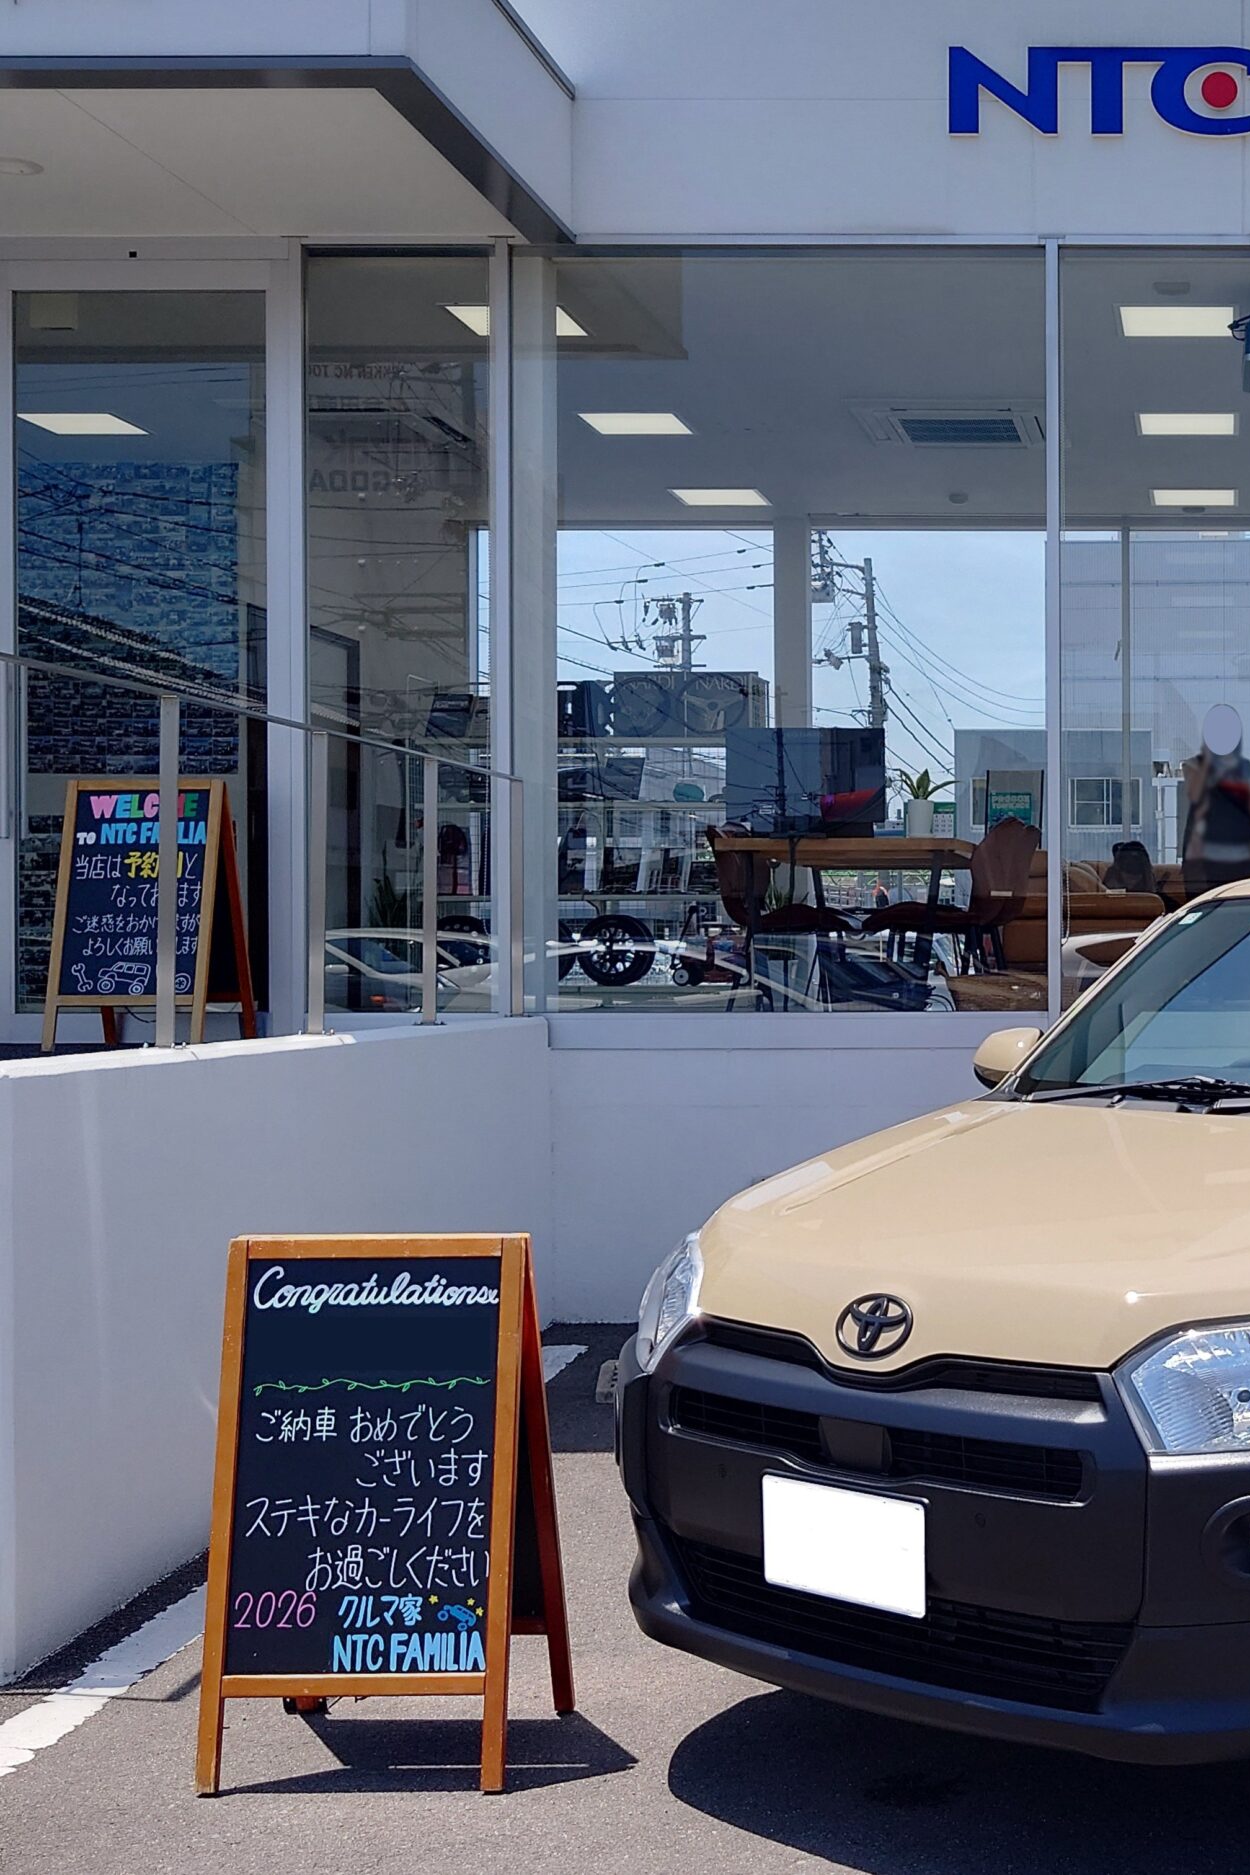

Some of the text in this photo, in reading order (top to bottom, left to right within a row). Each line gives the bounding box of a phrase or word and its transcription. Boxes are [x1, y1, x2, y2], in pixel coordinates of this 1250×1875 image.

[90, 793, 199, 819] WELCE
[76, 821, 207, 845] TO NTC FALIA
[76, 851, 199, 880] 当店は予約と
[110, 881, 202, 908] なっておます
[255, 1404, 474, 1443] ご納車 おめでとう
[355, 1448, 489, 1488] ございます
[245, 1494, 486, 1539] ステキなカーライフを
[305, 1544, 490, 1592] お過ごしください
[233, 1590, 317, 1629] 2026
[337, 1595, 424, 1629] クルマ家
[332, 1630, 487, 1672] NTC FAMILIA
